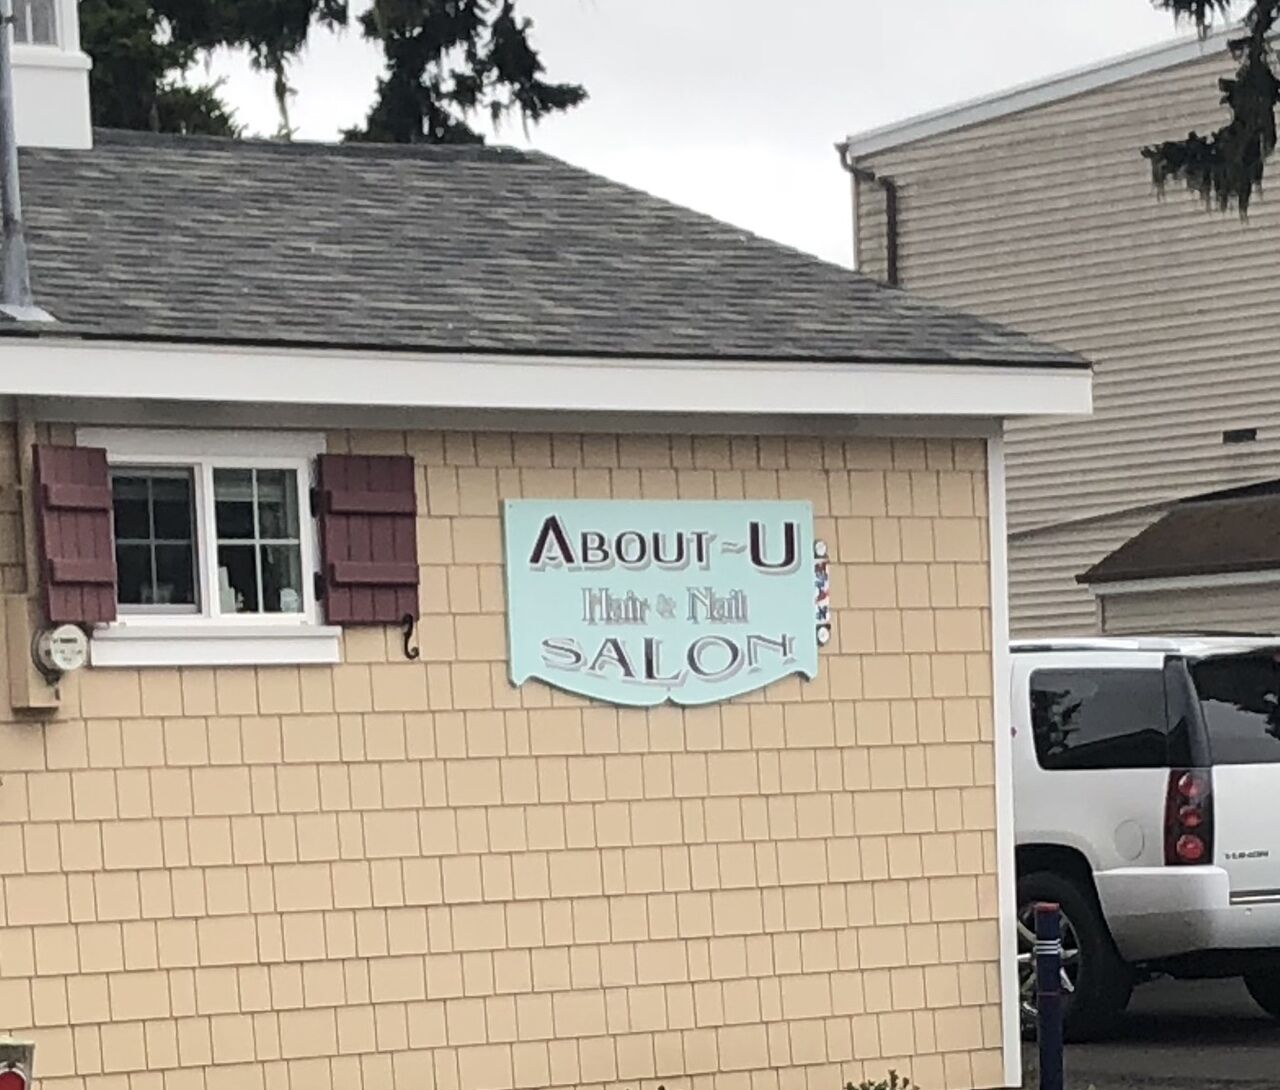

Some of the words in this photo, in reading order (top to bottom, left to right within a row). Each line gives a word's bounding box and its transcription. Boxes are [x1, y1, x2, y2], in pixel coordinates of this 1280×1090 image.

[581, 586, 649, 626] Hair
[687, 585, 749, 626] Nail
[541, 633, 797, 687] SALON
